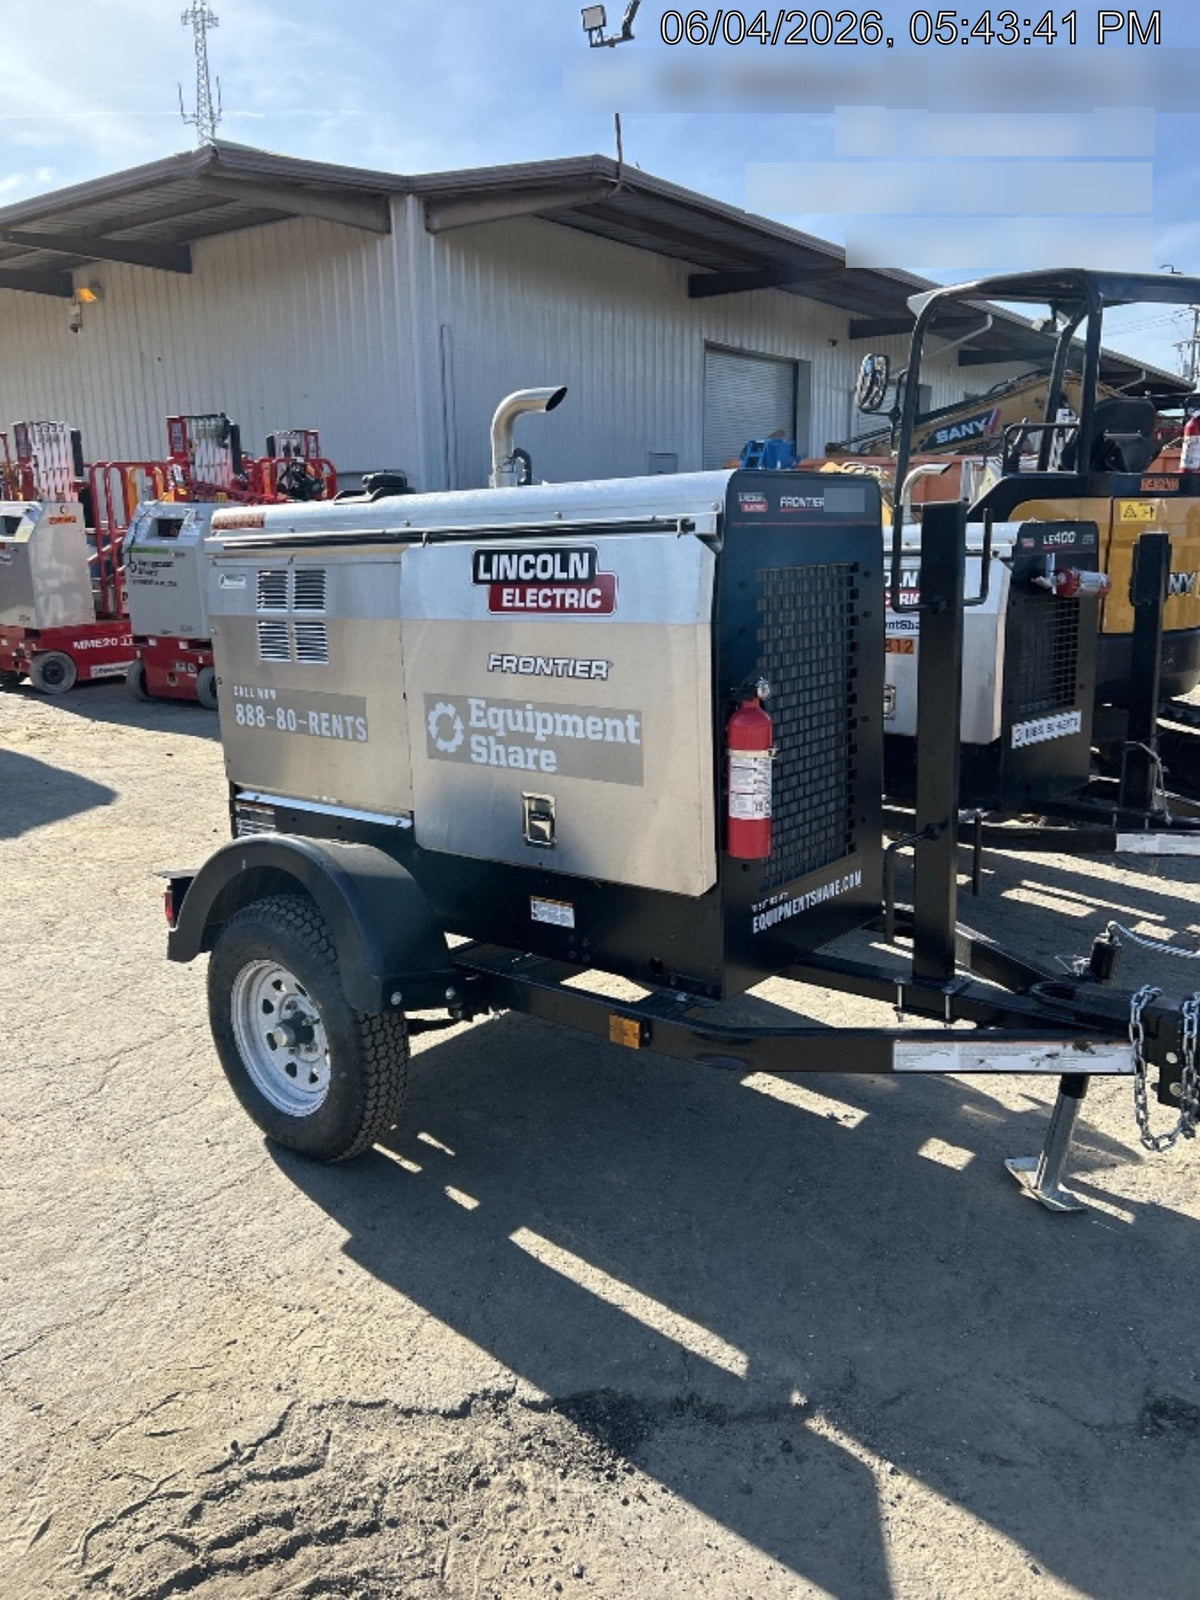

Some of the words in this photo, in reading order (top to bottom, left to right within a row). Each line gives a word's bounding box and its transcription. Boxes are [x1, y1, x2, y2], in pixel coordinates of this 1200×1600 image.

[935, 418, 987, 443] SANY
[477, 552, 590, 581] LINCOLN
[1168, 572, 1196, 594] NY
[501, 587, 602, 609] ELECTRIC
[487, 653, 609, 680] FRONTIER
[235, 703, 367, 741] 888-80-RENTS
[467, 698, 641, 745] Equipment
[470, 734, 558, 772] Share
